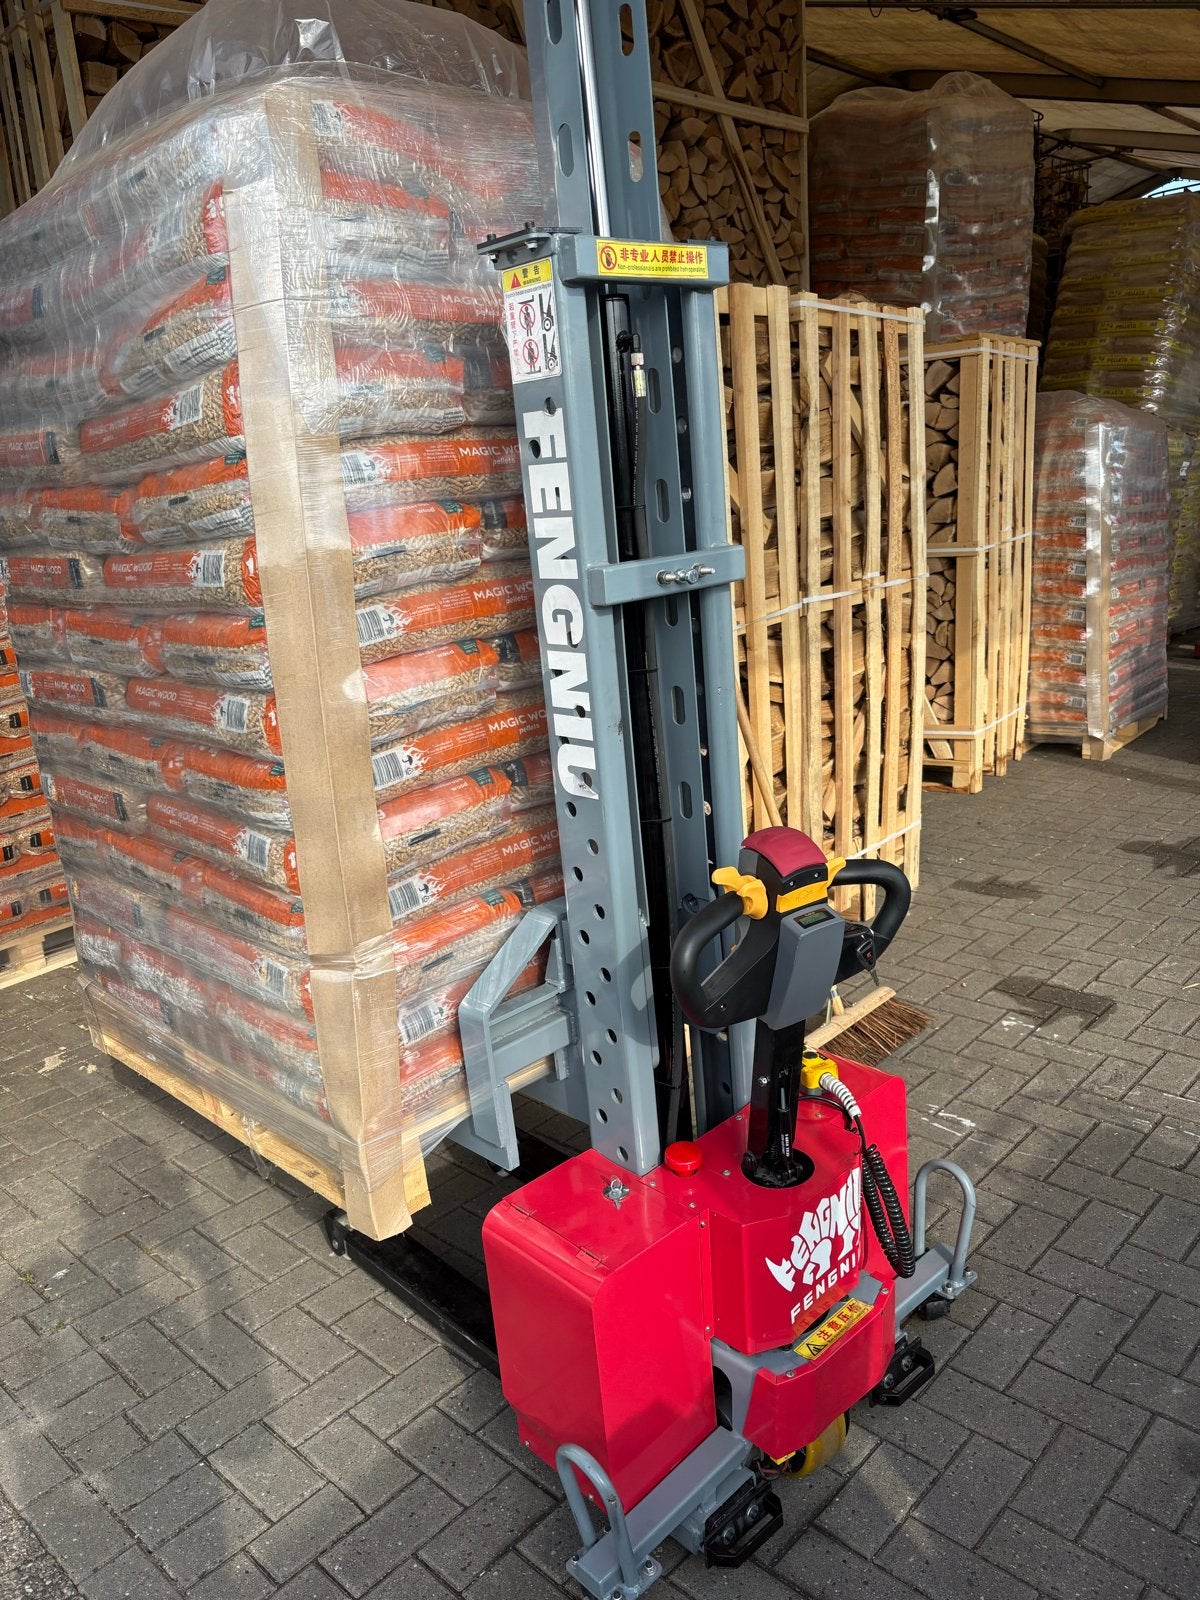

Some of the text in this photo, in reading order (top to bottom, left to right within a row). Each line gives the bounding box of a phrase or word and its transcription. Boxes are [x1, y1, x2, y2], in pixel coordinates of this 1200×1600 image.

[620, 247, 703, 265] 非专业人员禁止操作
[522, 265, 540, 279] 警告
[459, 446, 500, 457] MAGIC
[492, 457, 515, 467] pellets
[473, 585, 513, 601] MAGIC
[505, 595, 528, 606] pellets
[523, 408, 599, 800] FENGNIU
[135, 685, 156, 698] MAGIC
[157, 689, 177, 701] WOOD
[488, 714, 527, 733] MAGIC
[527, 709, 547, 722] WO
[518, 724, 540, 735] pellets
[155, 801, 199, 825] MAGIC WOOD
[501, 829, 559, 857] MAGIC WO
[531, 843, 552, 857] pellets
[790, 1256, 860, 1325] FENGNI
